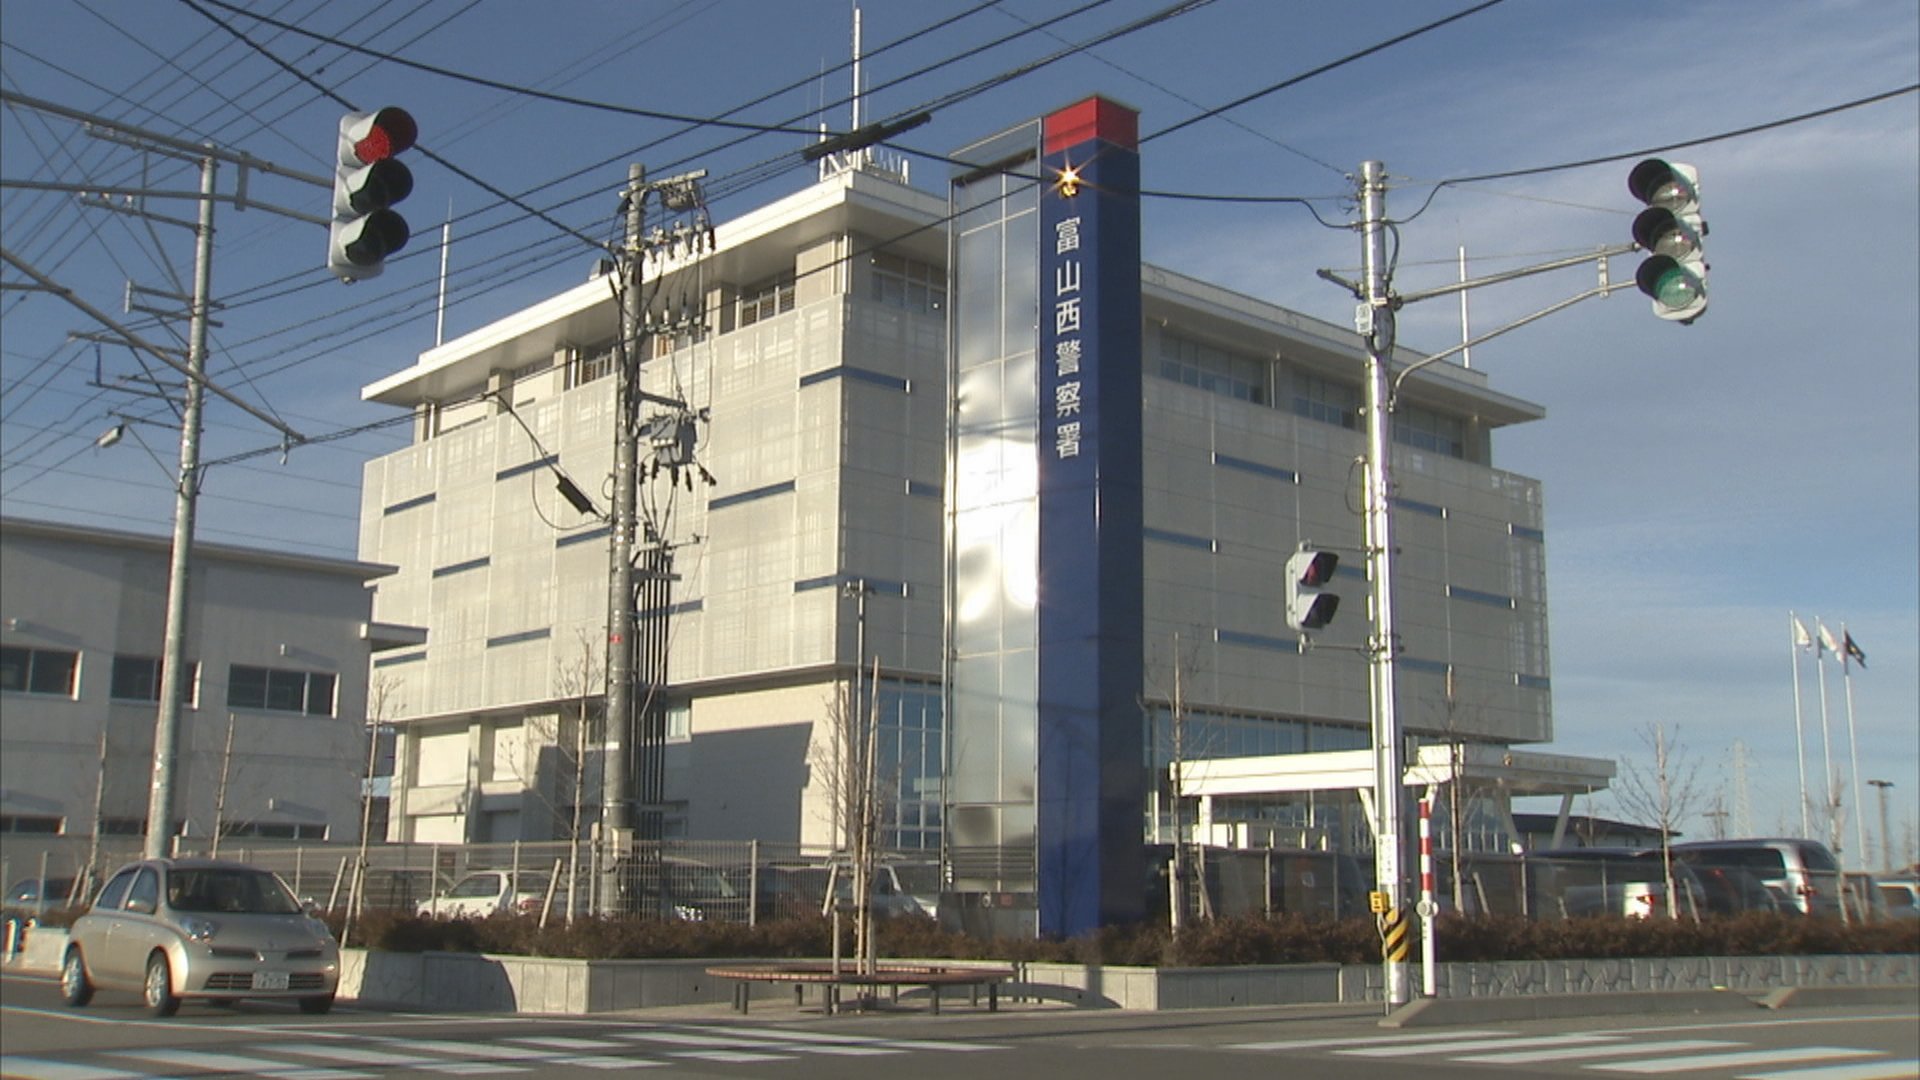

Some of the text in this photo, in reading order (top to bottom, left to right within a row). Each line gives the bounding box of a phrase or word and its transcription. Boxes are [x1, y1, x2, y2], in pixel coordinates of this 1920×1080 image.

[1055, 216, 1082, 459] 富山西警察署
